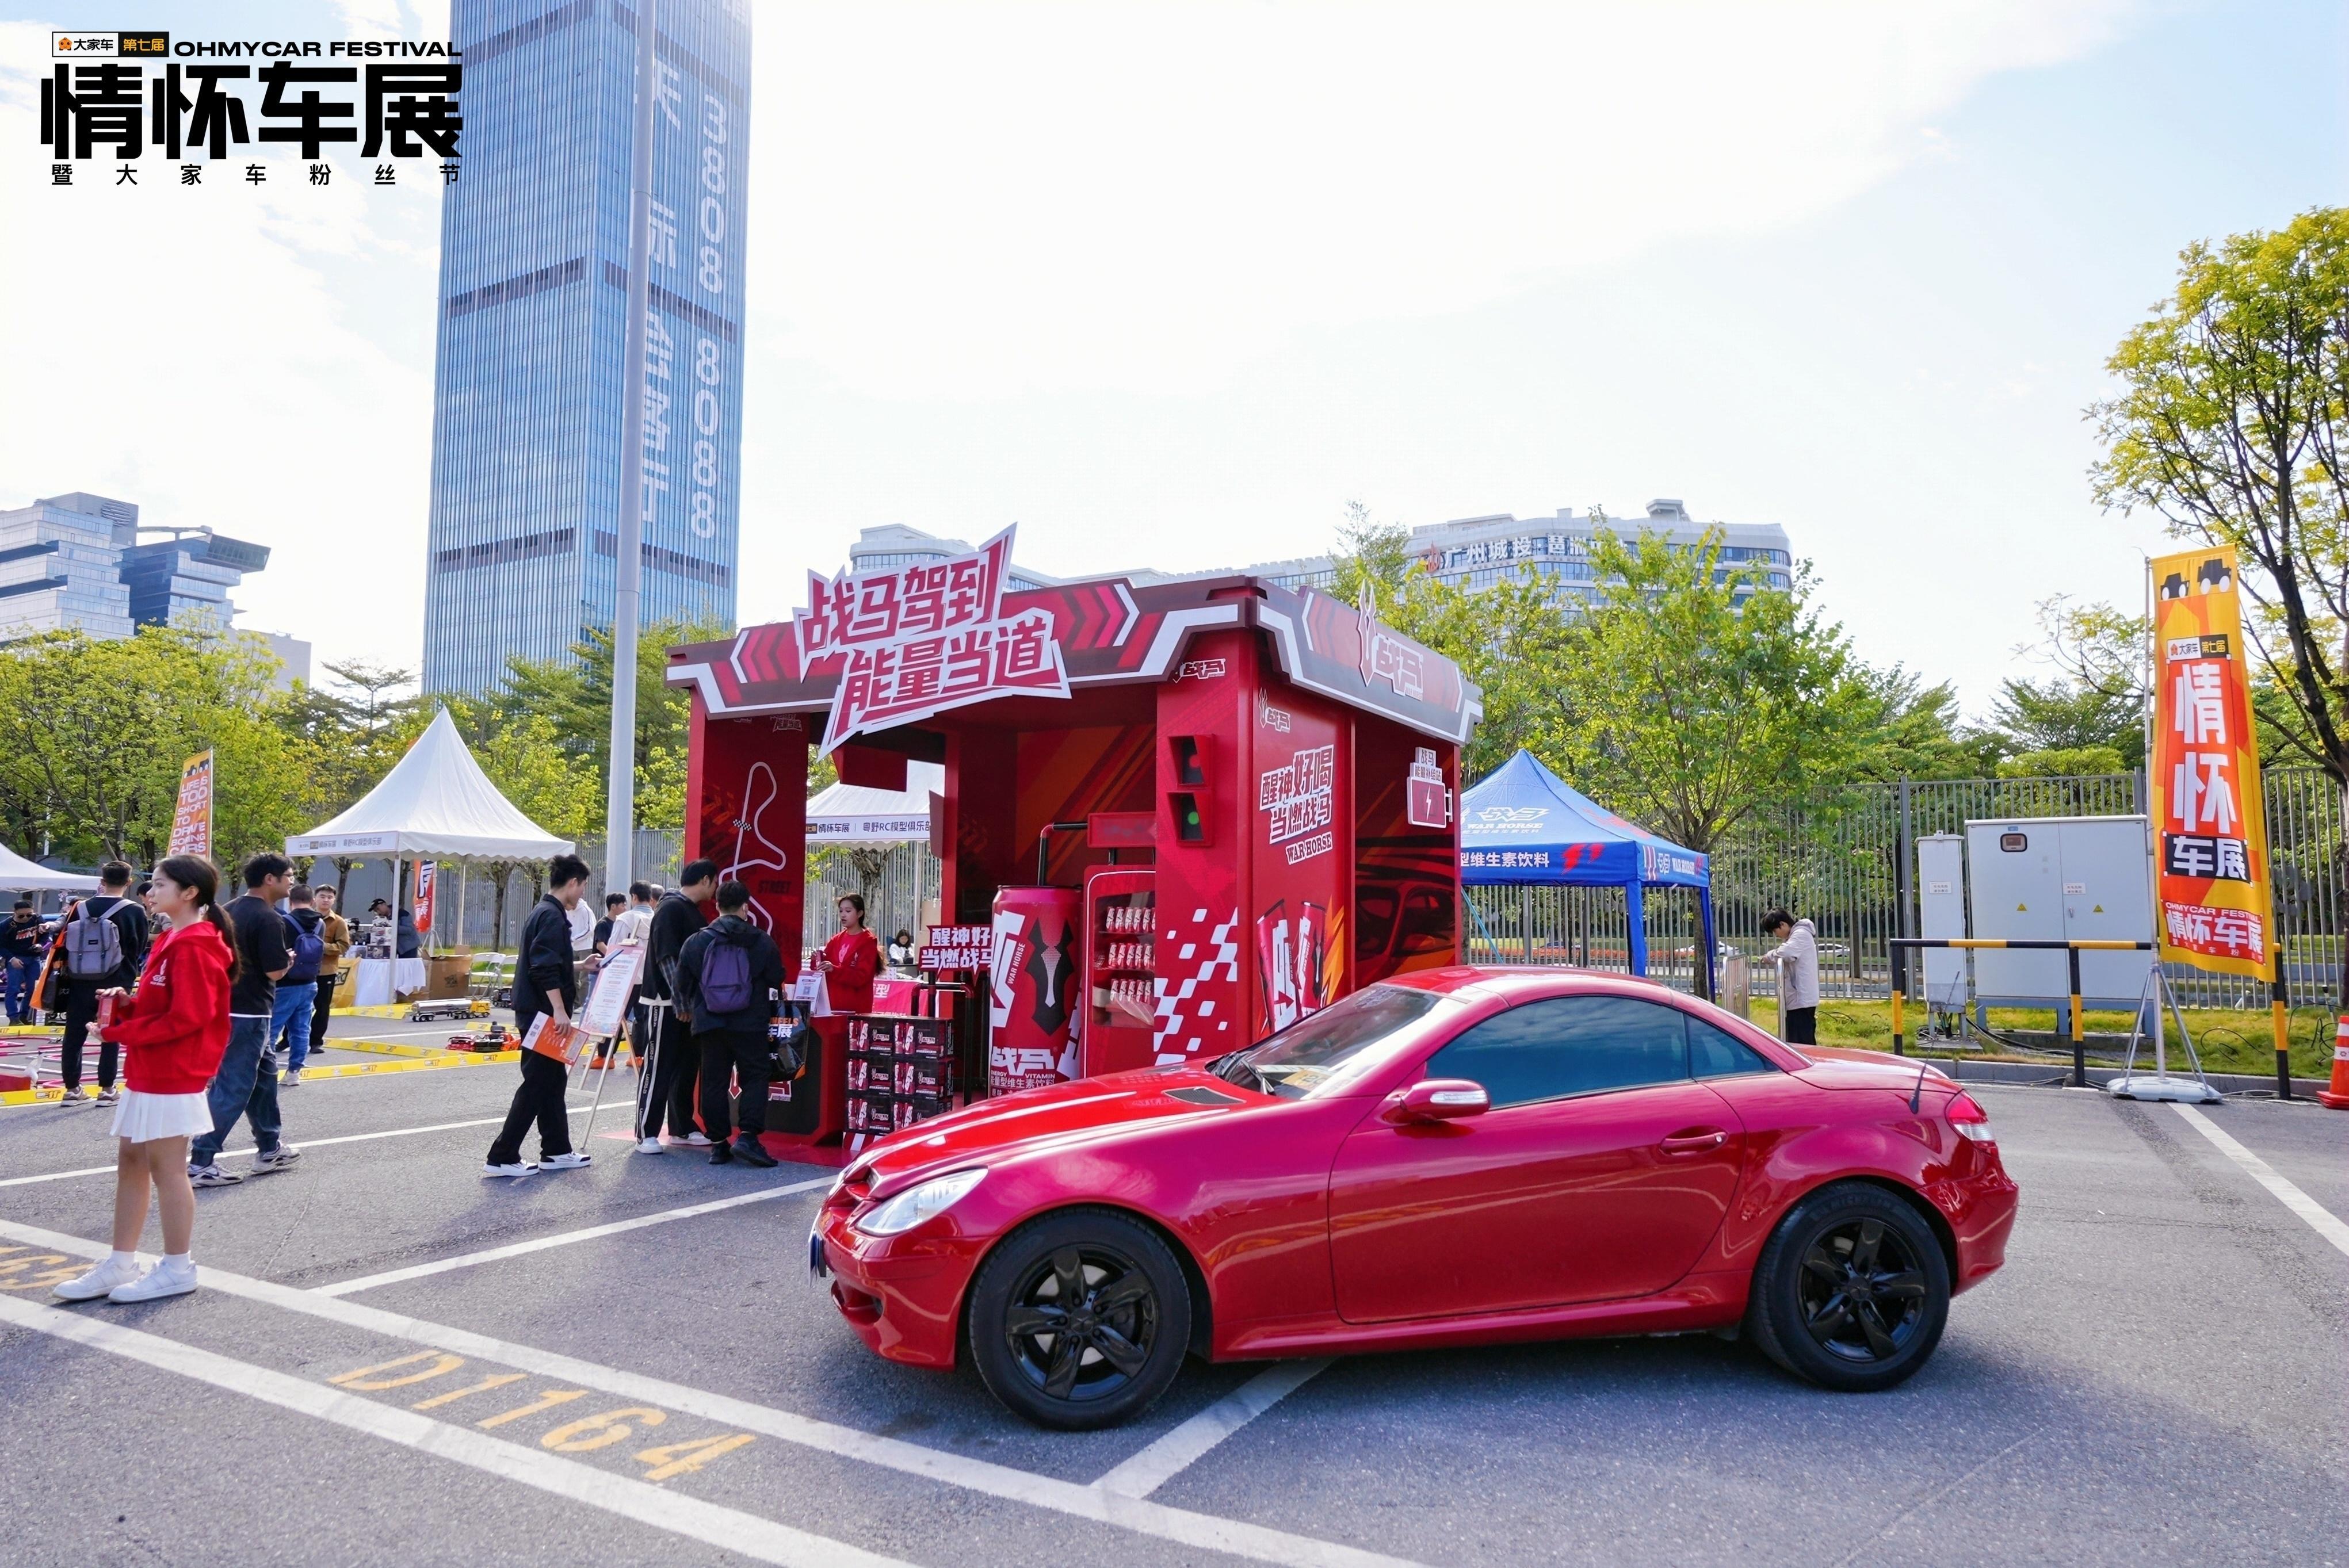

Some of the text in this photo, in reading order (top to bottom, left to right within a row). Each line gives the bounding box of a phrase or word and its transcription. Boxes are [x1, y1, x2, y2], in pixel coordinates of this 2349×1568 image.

[804, 535, 1009, 652] 战马驾到
[2179, 644, 2198, 655] 大家车
[2202, 640, 2225, 653] 第七届
[834, 616, 1061, 740] 能量当道
[2174, 663, 2236, 832] 情怀
[1422, 750, 1434, 766] 战马
[1263, 747, 1332, 804] 醒神好喝
[182, 779, 199, 793] LIFE
[181, 786, 208, 805] TOO
[177, 800, 207, 816] SHORT
[1271, 794, 1331, 839] 当燃战马
[173, 821, 205, 838] DRIVE
[177, 816, 190, 826] TO
[818, 823, 850, 833] 情怀车展
[169, 842, 206, 856] CARS
[171, 833, 205, 847] BORING
[1287, 835, 1331, 861] WAR HORSE
[1461, 852, 1549, 867] 型维生素饮料
[2172, 837, 2248, 880] 车展
[2166, 902, 2215, 915] OHMYCAR
[932, 927, 990, 946] 醒神好
[2166, 910, 2263, 954] 情怀车展
[1007, 943, 1025, 984] WAR HORSE
[770, 1017, 799, 1027] HEELS
[991, 1046, 1055, 1076] 战马
[327, 1349, 757, 1481] D1164
